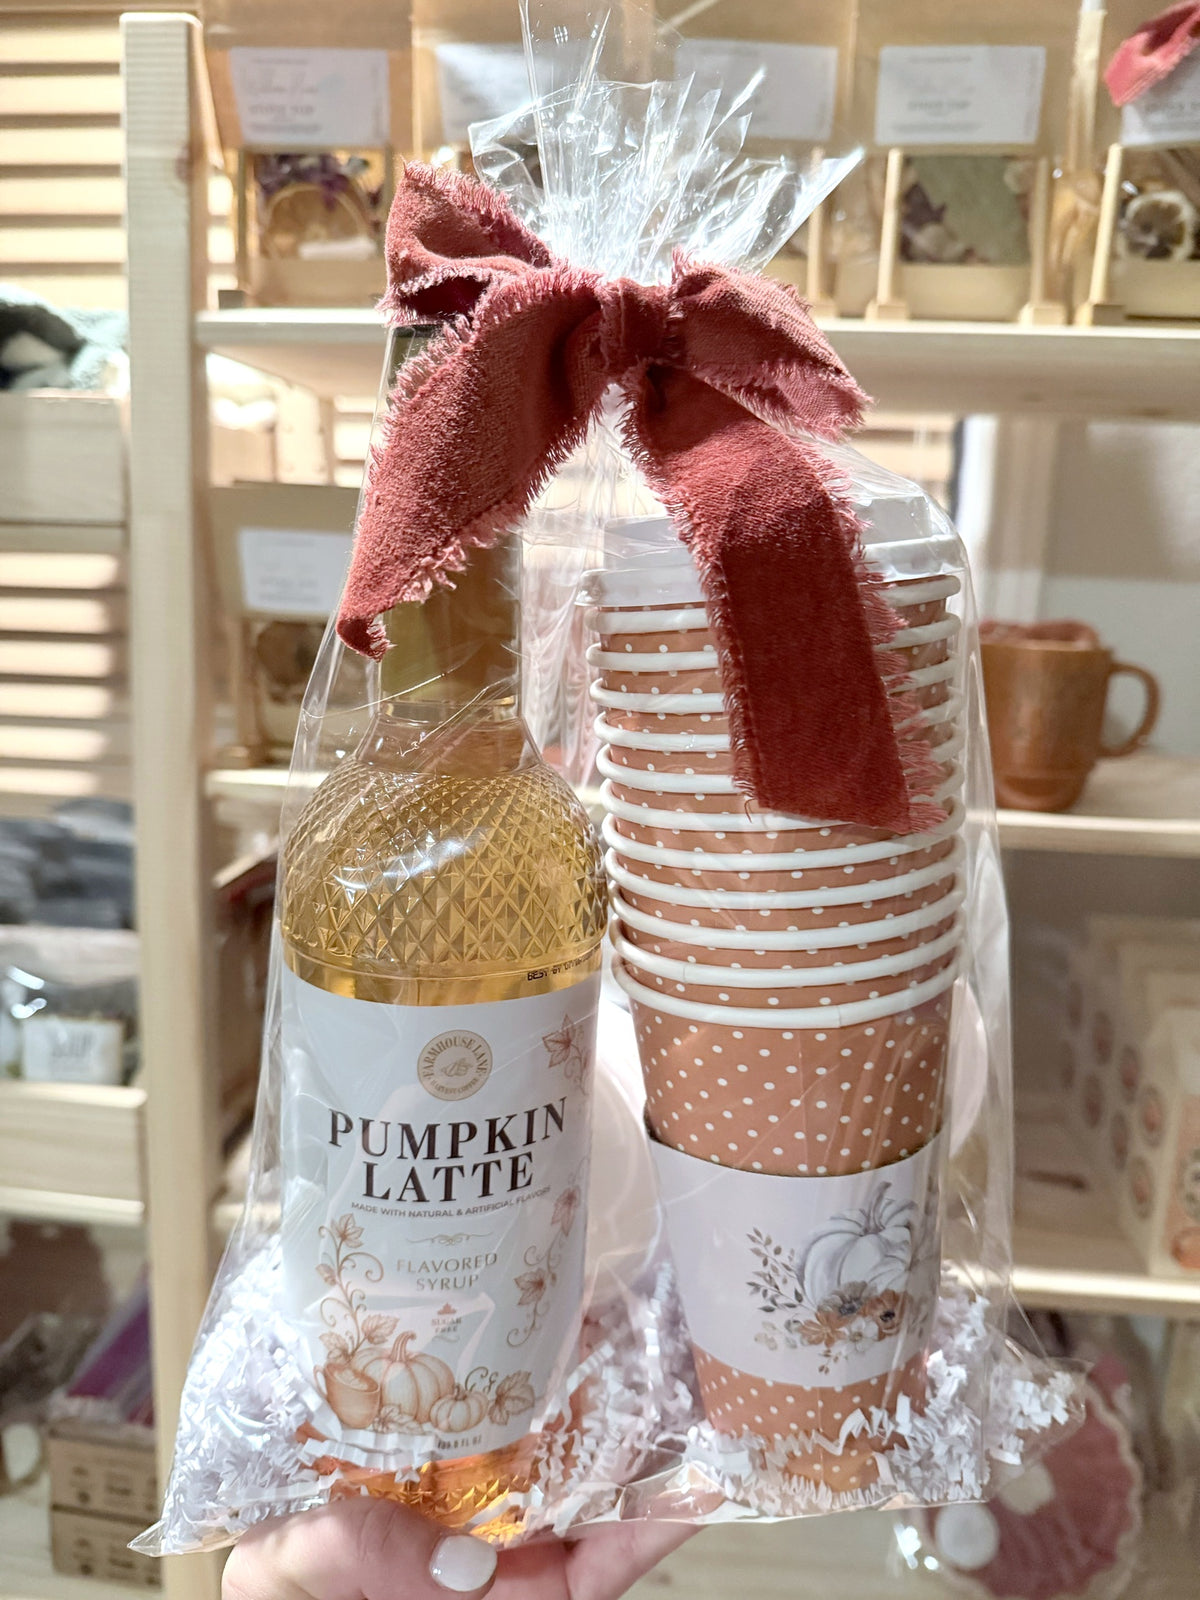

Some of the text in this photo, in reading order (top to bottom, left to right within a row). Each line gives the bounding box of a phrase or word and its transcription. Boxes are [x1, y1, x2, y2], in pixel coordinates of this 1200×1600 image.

[527, 968, 548, 981] BEST
[423, 1036, 489, 1077] FARMHOUSE LANE
[328, 1096, 567, 1160] PUMPKIN
[362, 1151, 533, 1202] LATTE
[351, 1201, 379, 1214] MADE
[381, 1206, 406, 1217] WITH
[408, 1208, 454, 1218] NATURAL
[456, 1207, 463, 1216] &
[465, 1199, 514, 1216] ARTIFICIAL
[397, 1252, 497, 1274] FLAVORED
[416, 1274, 479, 1292] SYRUP
